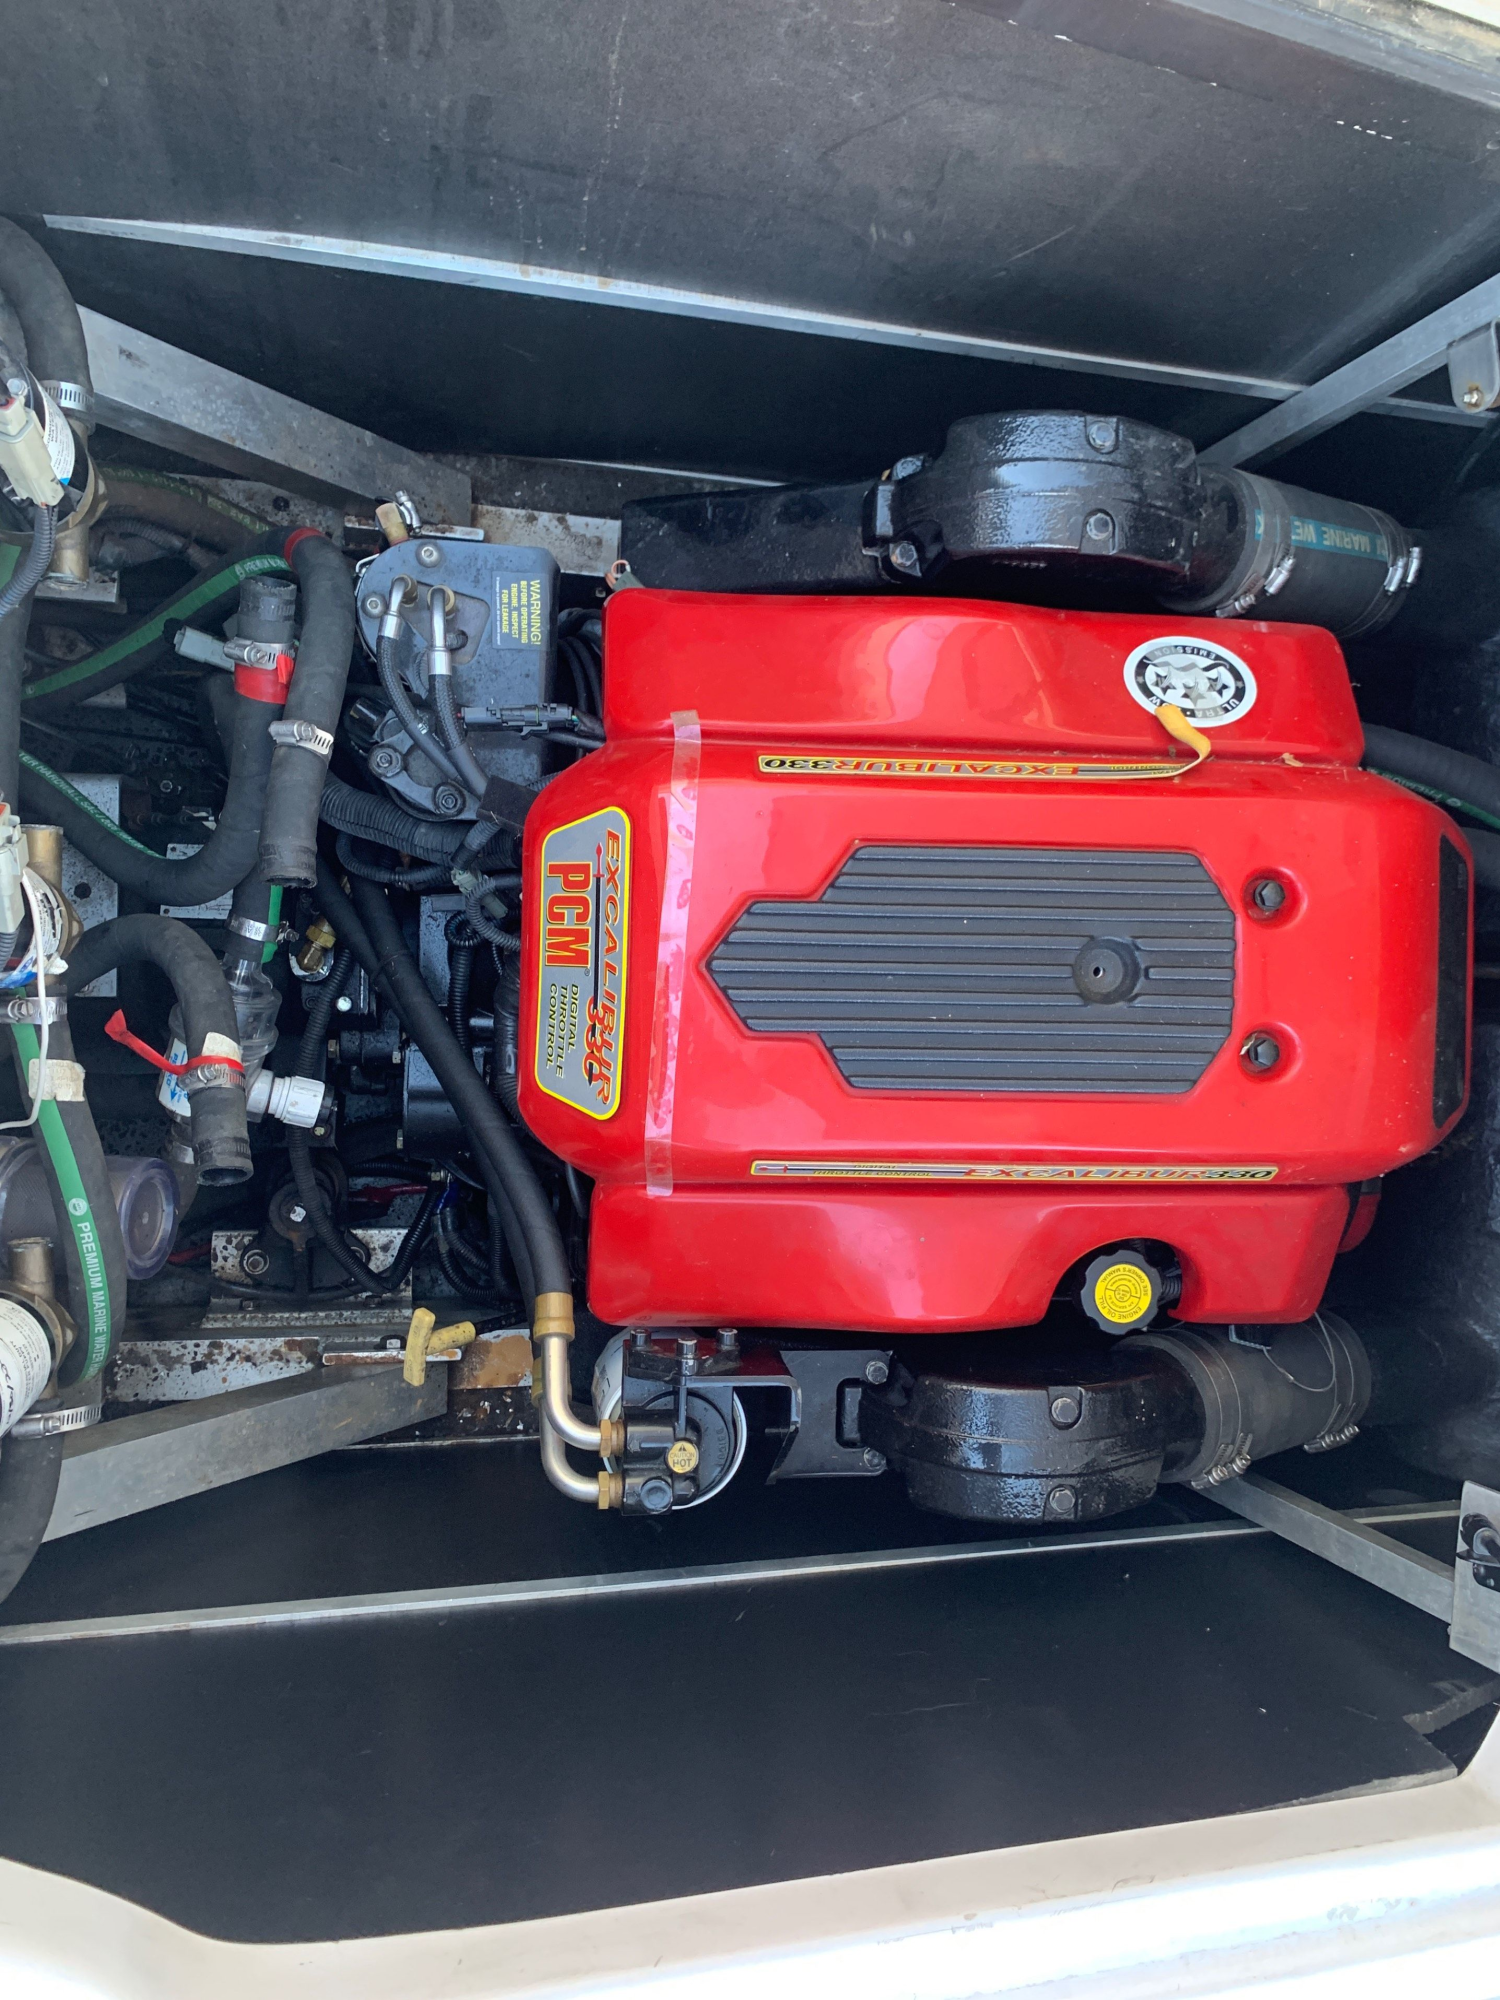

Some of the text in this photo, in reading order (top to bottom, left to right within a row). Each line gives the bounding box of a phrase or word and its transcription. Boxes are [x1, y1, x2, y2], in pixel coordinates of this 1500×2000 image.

[1321, 526, 1371, 553] MARINE
[501, 589, 510, 634] FOR LEAKAGE
[510, 583, 519, 638] ENGINE, INSPECT
[530, 579, 541, 645] WARNING!
[1153, 646, 1217, 660] EMISSION
[1194, 698, 1240, 718] ULTRA
[545, 861, 592, 968] PCM
[596, 828, 621, 1105] EXCALIBUR
[545, 983, 558, 1070] CONTROL
[555, 984, 569, 1079] THROTTLE
[567, 983, 580, 1053] DIGITAL
[583, 995, 607, 1084] 330
[813, 1169, 874, 1177] THROTTLE
[76, 1221, 104, 1289] PREMIUM
[1100, 1267, 1121, 1283] MANUAL
[92, 1290, 107, 1334] MARINE
[1098, 1294, 1107, 1310] FILL
[1106, 1309, 1117, 1318] OIL
[1117, 1306, 1142, 1320] ENGINE
[92, 1334, 107, 1366] WATER
[669, 1451, 695, 1459] CAUTION
[672, 1458, 693, 1468] HOT
